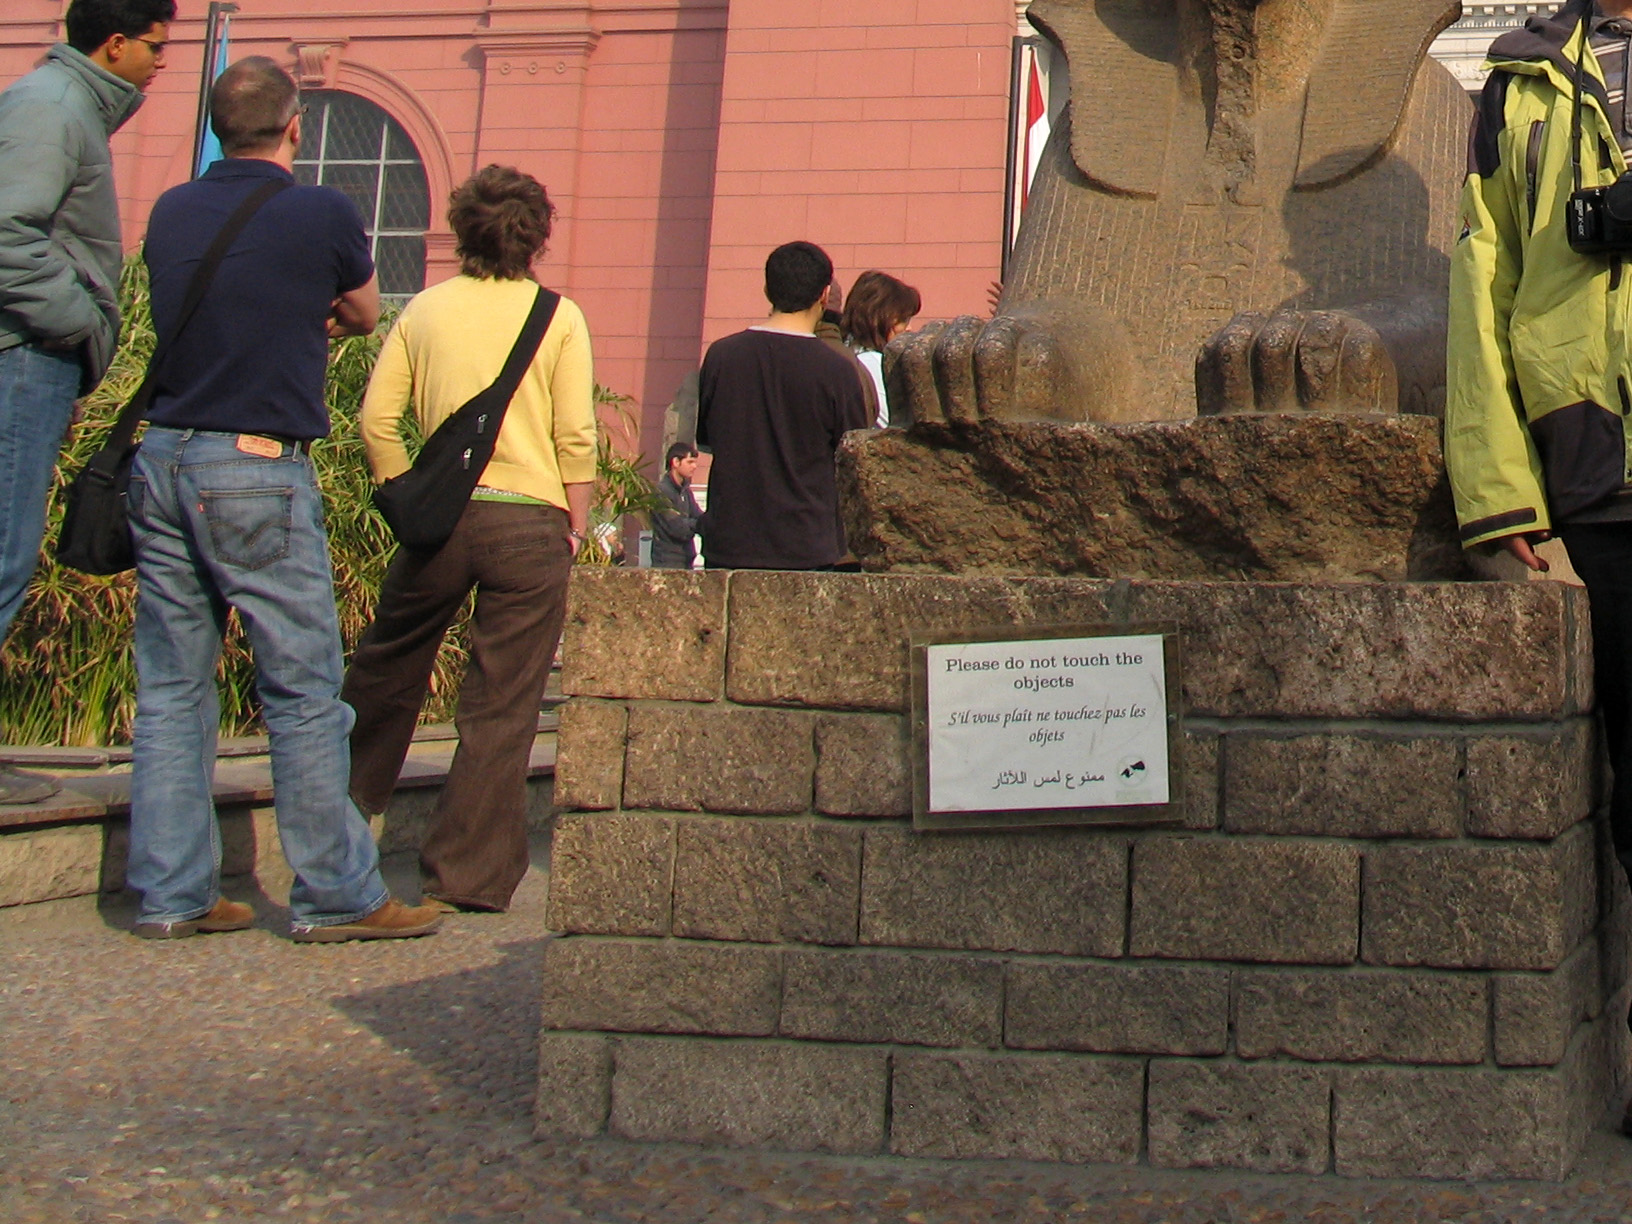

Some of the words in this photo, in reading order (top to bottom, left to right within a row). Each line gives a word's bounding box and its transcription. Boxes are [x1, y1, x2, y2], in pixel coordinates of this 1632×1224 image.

[945, 657, 1000, 672] Please
[1004, 656, 1025, 670] do
[1029, 655, 1057, 669] not
[1062, 652, 1110, 668] touch
[1115, 652, 1143, 666] the
[1013, 675, 1074, 692] objects
[948, 709, 971, 726] S'il
[972, 710, 1001, 723] vous
[1002, 708, 1032, 728] plaît
[1036, 709, 1051, 721] ne
[1054, 705, 1102, 721] touchez
[1104, 706, 1126, 725] pas
[1130, 703, 1146, 719] les
[1029, 730, 1065, 747] objets
